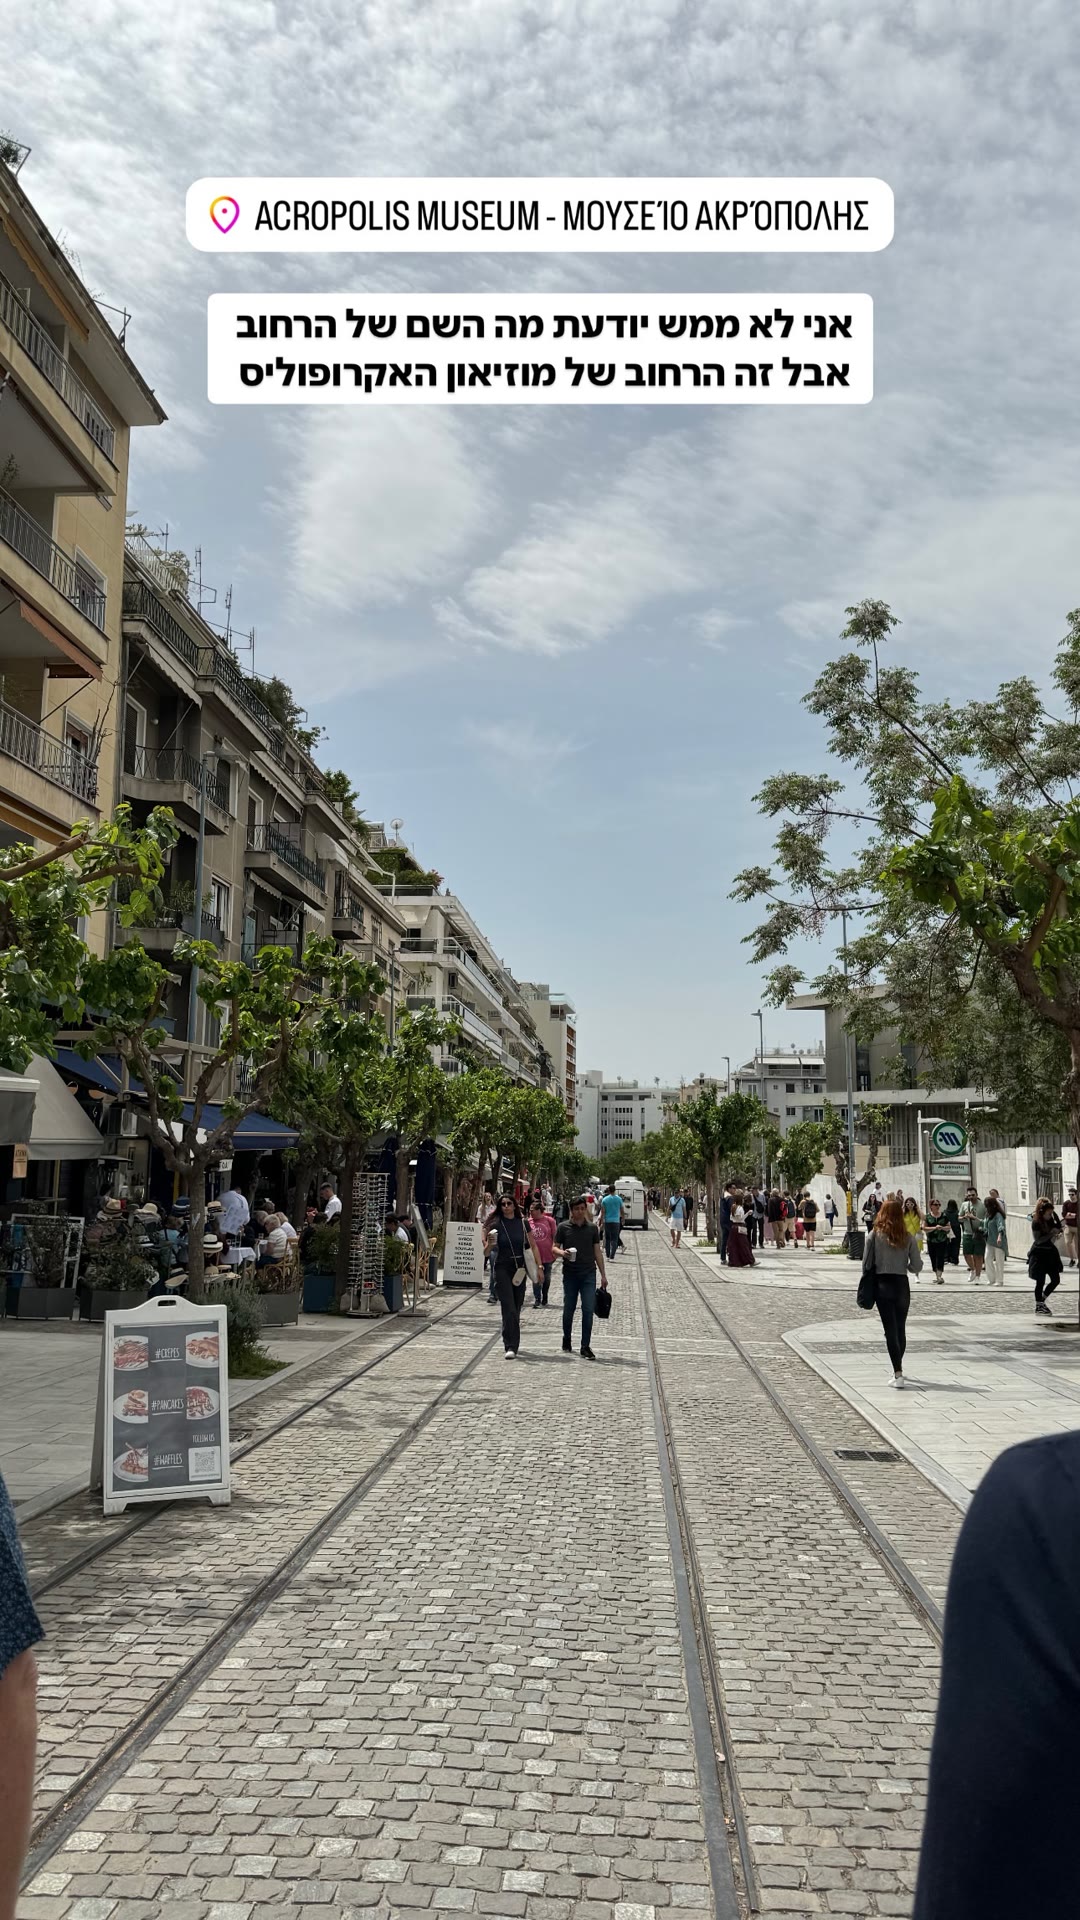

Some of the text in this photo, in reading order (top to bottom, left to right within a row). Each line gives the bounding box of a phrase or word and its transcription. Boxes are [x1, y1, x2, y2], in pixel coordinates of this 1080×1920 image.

[155, 1347, 180, 1359] #CREPES
[151, 1398, 184, 1411] #PANCAKES
[153, 1453, 183, 1466] #WAFFLES
